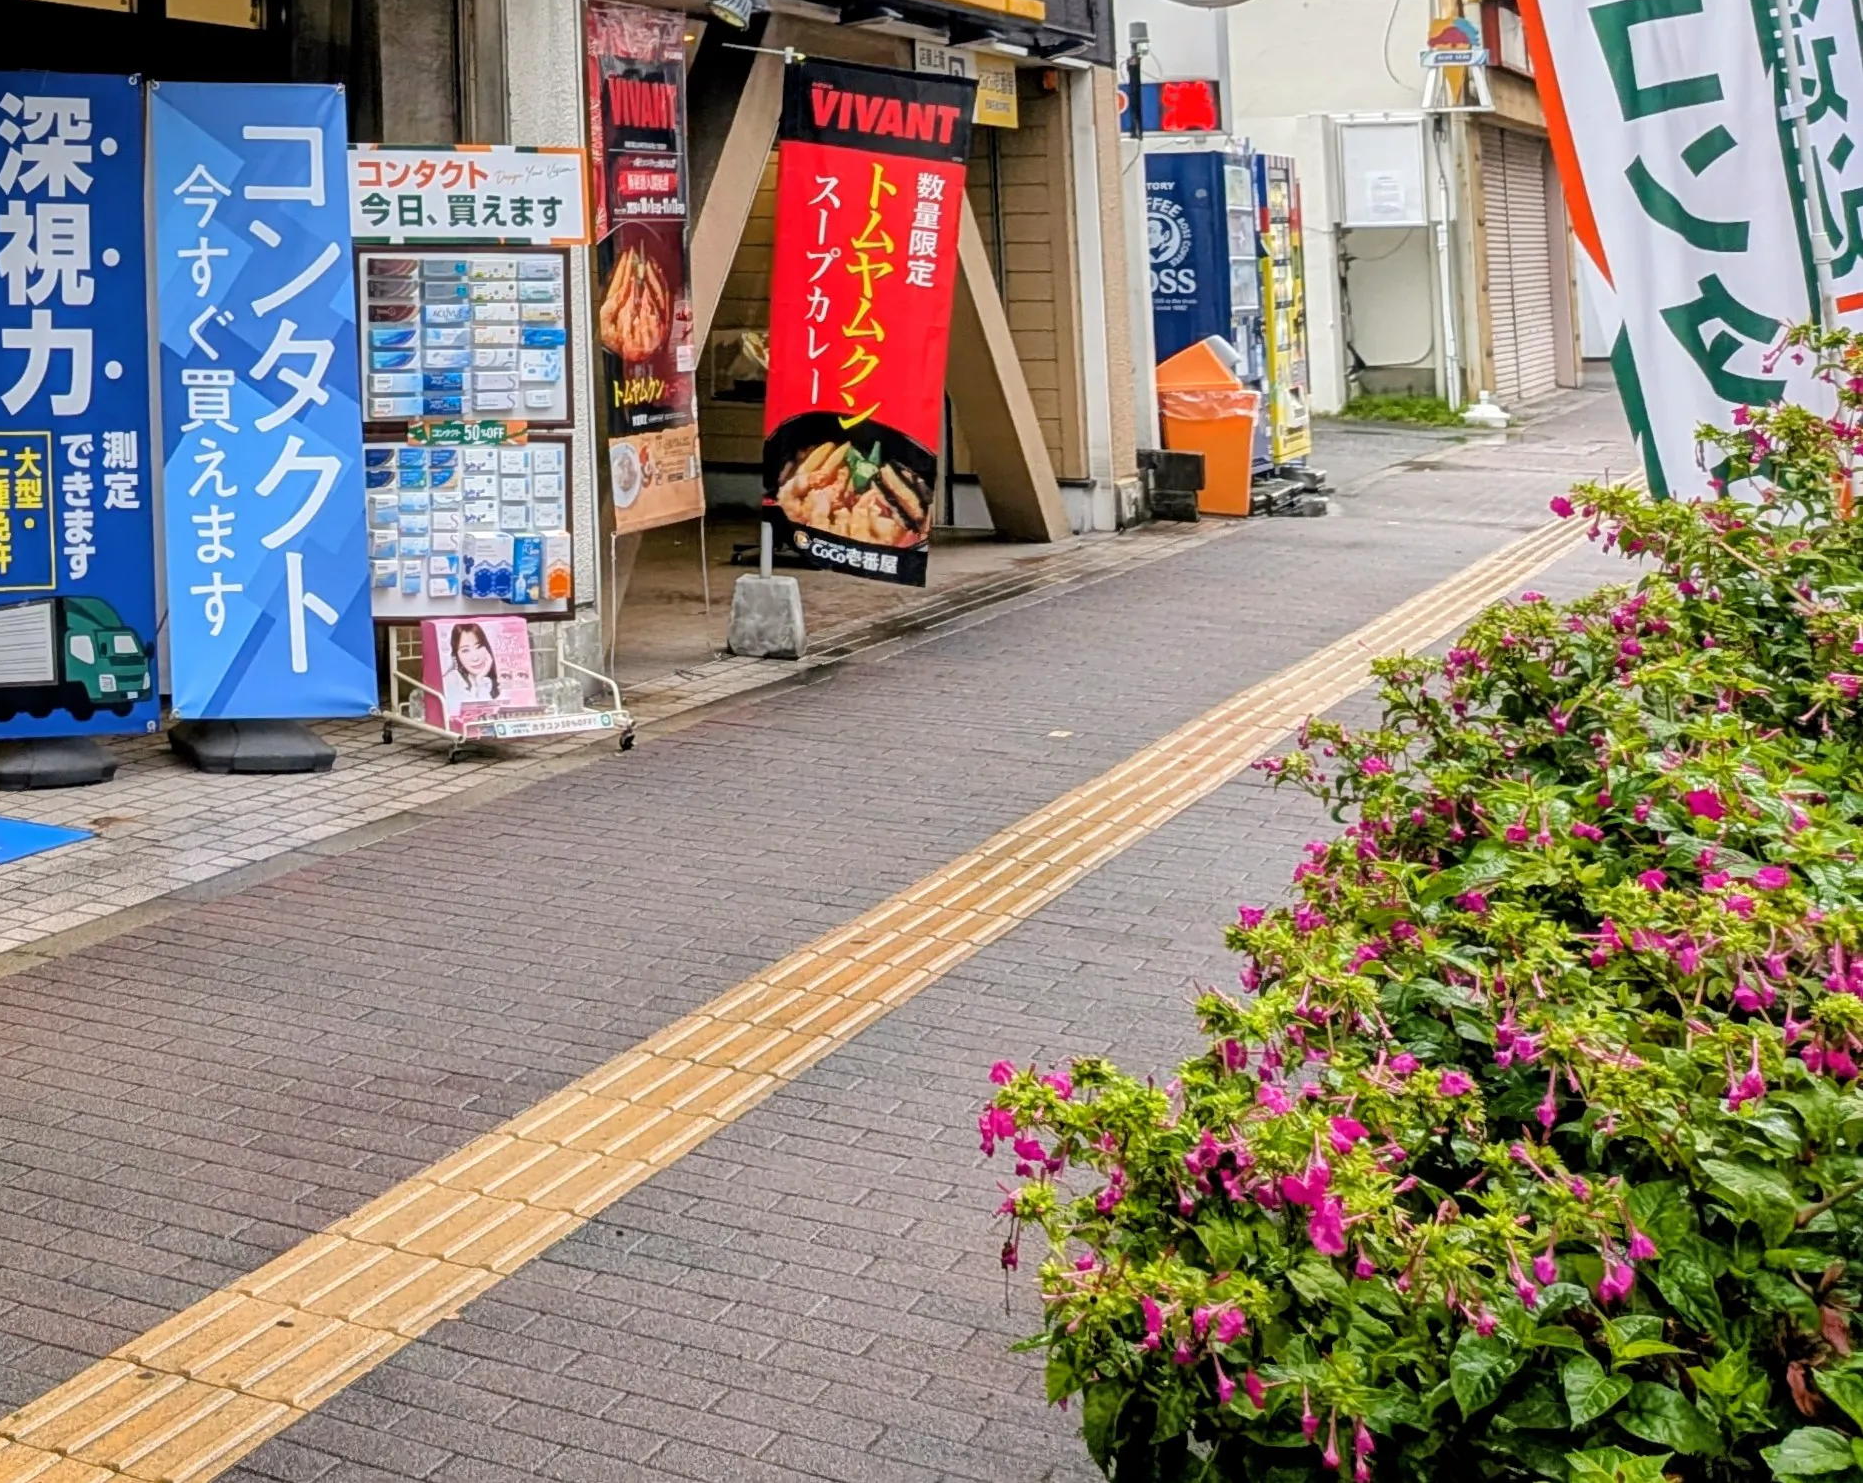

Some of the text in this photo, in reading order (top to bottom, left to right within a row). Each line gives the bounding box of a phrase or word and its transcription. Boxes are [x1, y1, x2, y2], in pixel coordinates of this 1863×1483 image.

[608, 78, 678, 130] VIVANT
[811, 88, 961, 144] VIVANT
[358, 159, 488, 189] コンタクト
[360, 192, 563, 227] 今日、買えます
[906, 172, 945, 289] 数量限定
[804, 175, 842, 406] スープカレー
[838, 163, 895, 430] トムヤムクン
[173, 163, 243, 636] 今すぐ買えます
[242, 125, 341, 673] コンタクト
[60, 433, 95, 579] できます
[103, 431, 139, 510] 測定
[811, 543, 898, 574] CoCo壱番屋
